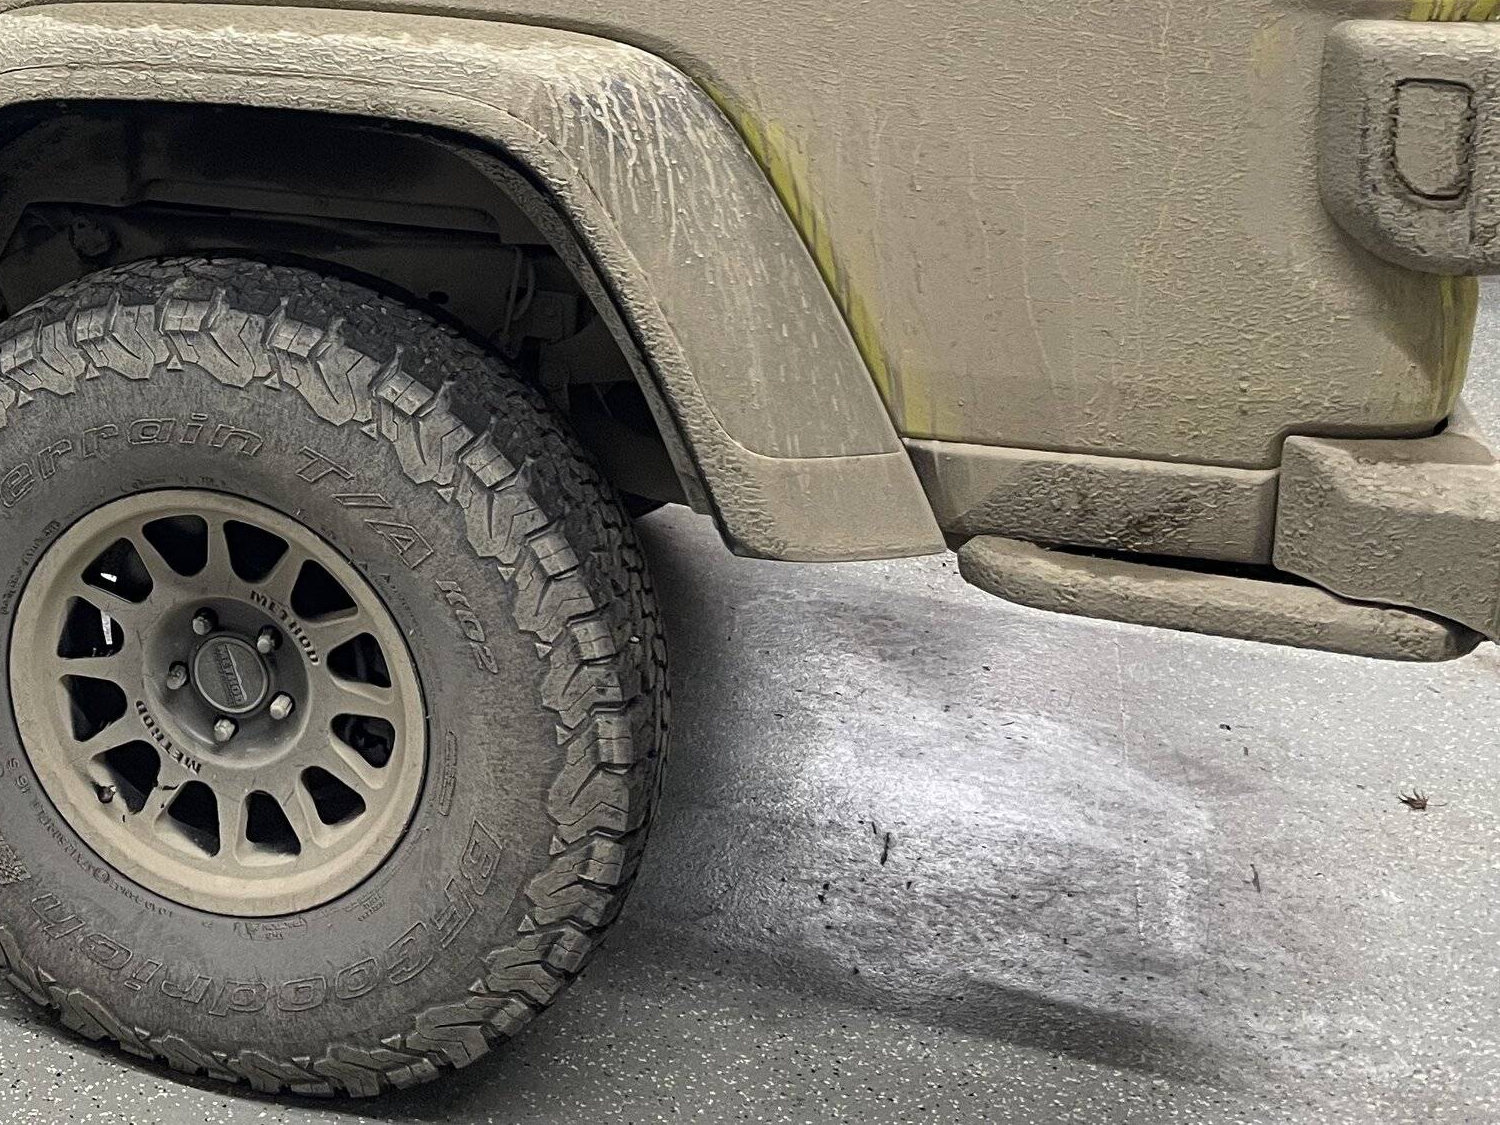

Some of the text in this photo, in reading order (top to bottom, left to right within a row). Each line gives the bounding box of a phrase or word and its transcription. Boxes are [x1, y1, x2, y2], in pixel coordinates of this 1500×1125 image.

[250, 590, 319, 666] METHOD
[295, 446, 434, 569] T/A
[436, 579, 499, 674] KO2
[137, 700, 202, 774] METHOD
[30, 819, 504, 1017] BFGoodrich
